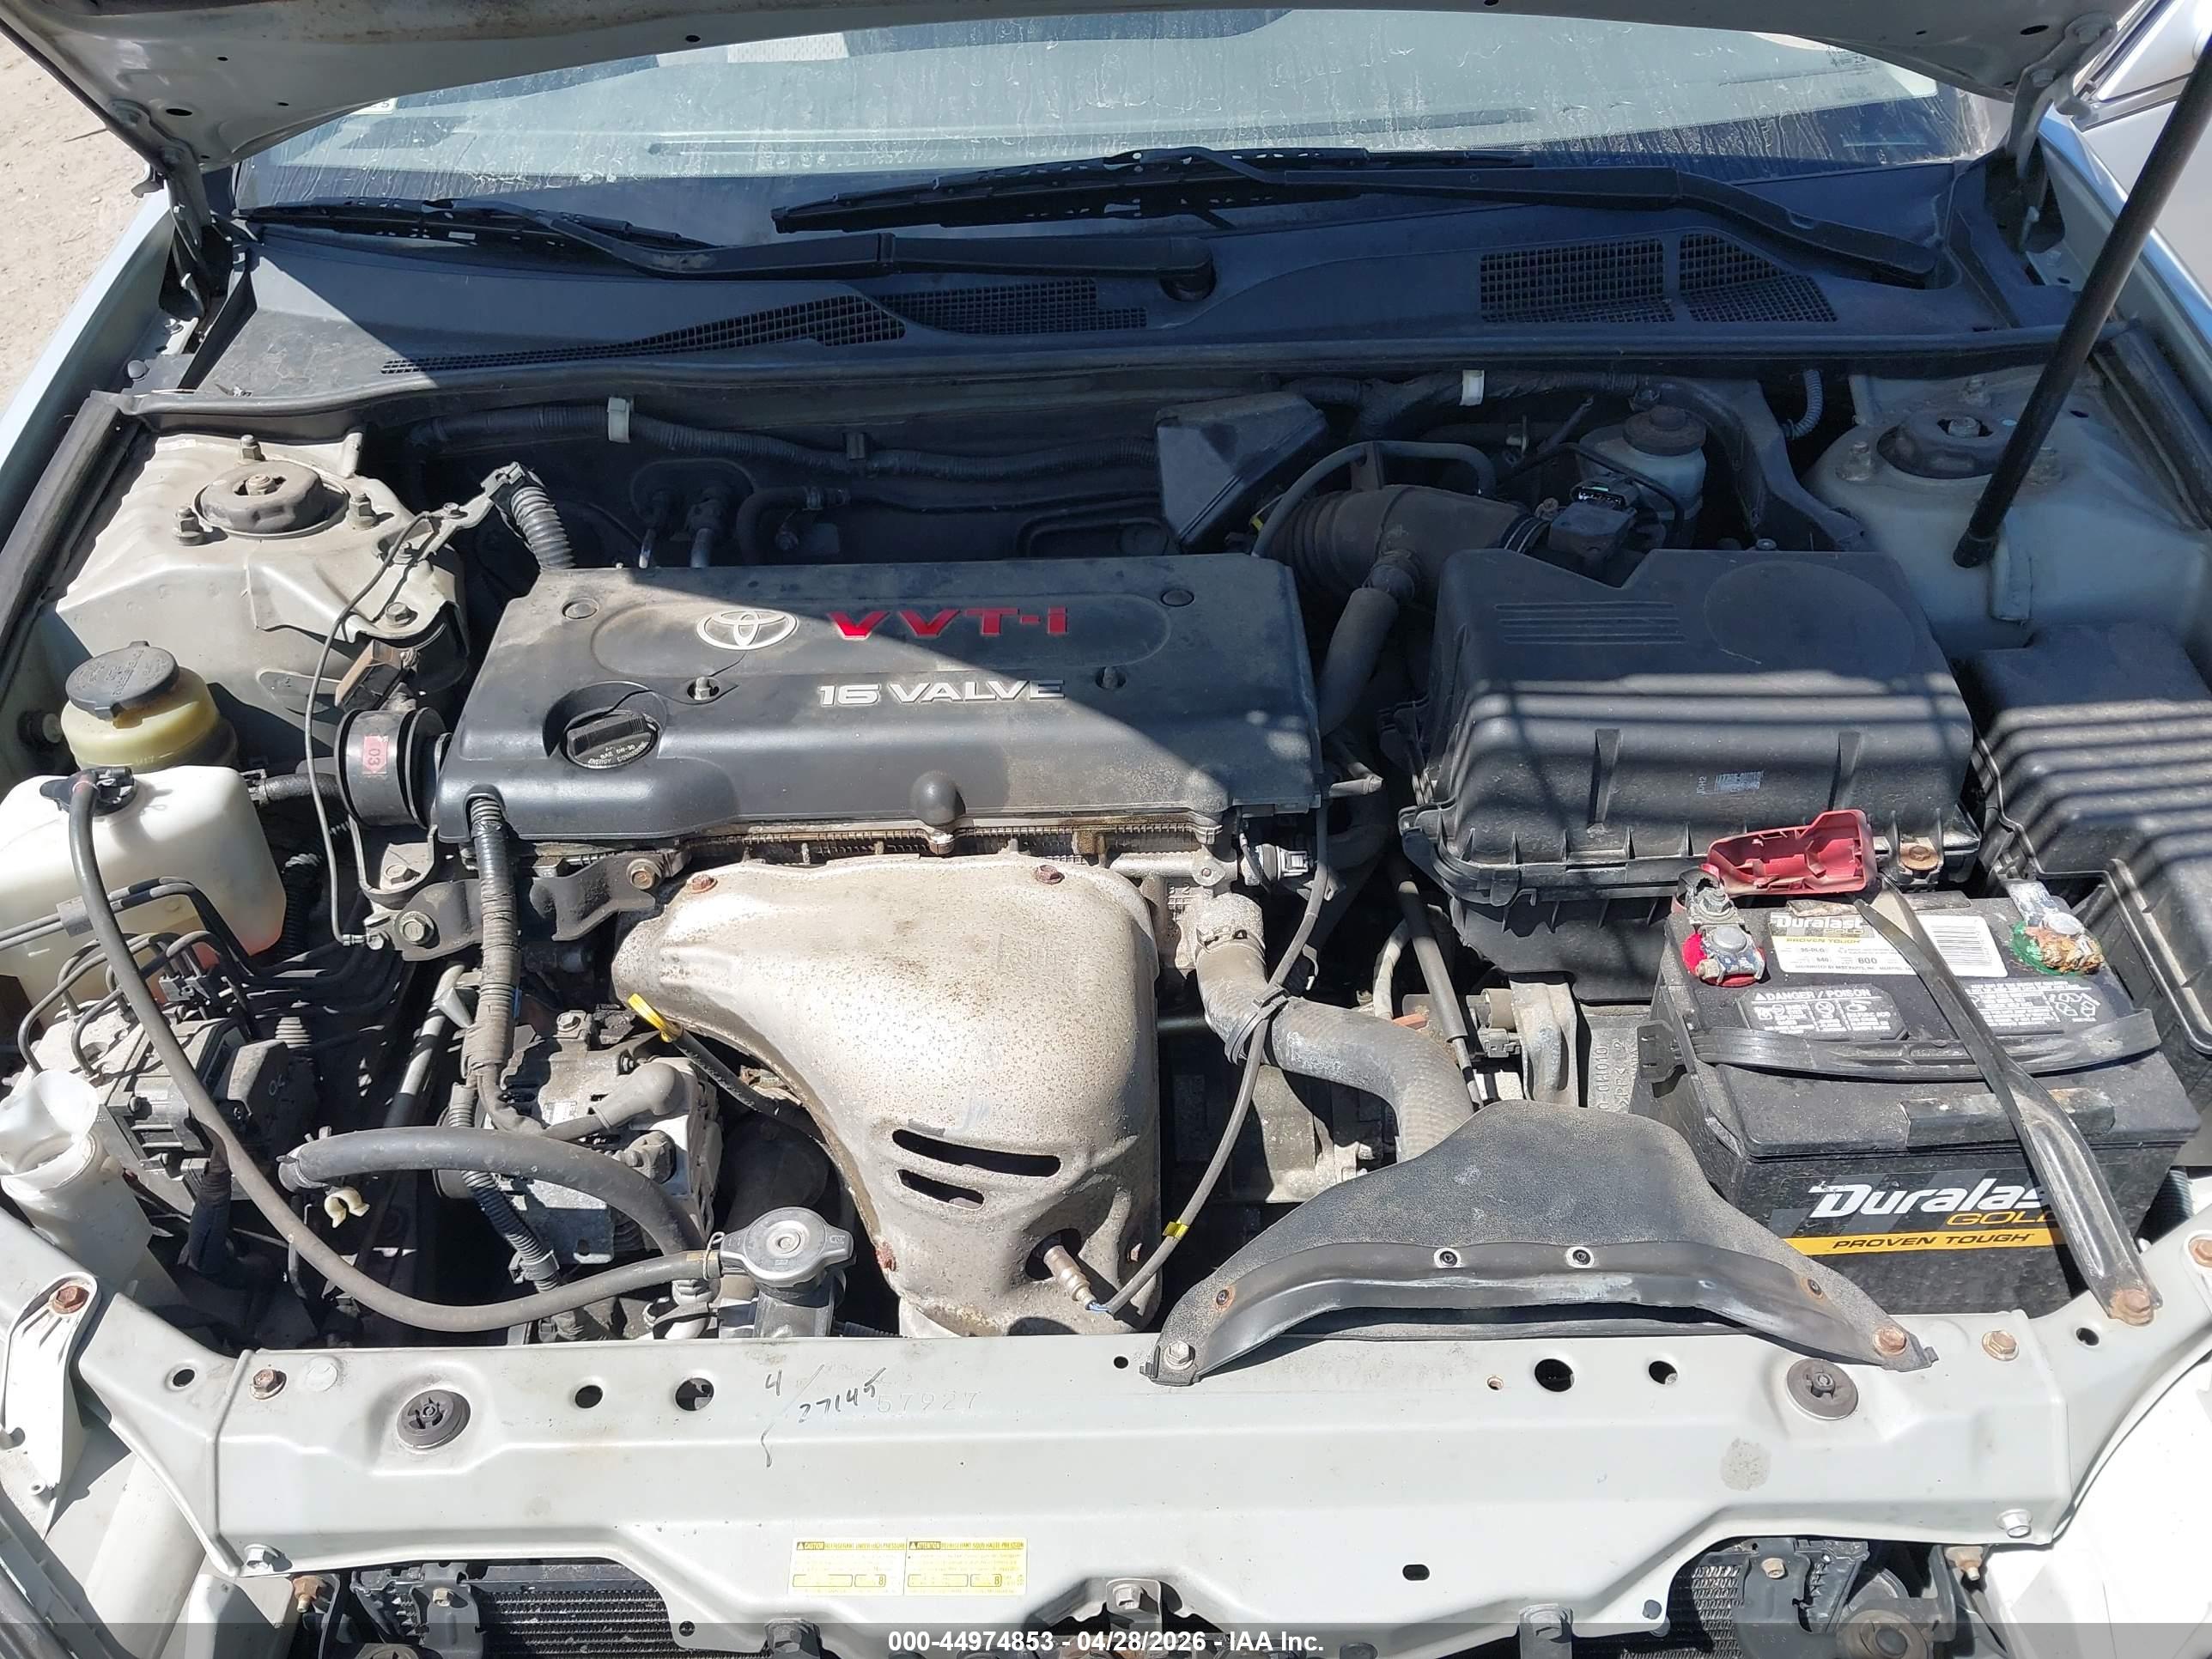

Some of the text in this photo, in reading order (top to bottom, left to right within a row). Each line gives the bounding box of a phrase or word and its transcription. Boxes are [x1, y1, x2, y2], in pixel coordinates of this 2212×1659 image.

[818, 680, 1066, 708] 16 VALVE
[368, 748, 381, 766] 03
[1765, 991, 1814, 1000] DANGER
[1826, 988, 1871, 998] POISON
[1832, 1233, 2028, 1249] PROVEN TOUGH
[805, 1541, 824, 1550] CAUTION
